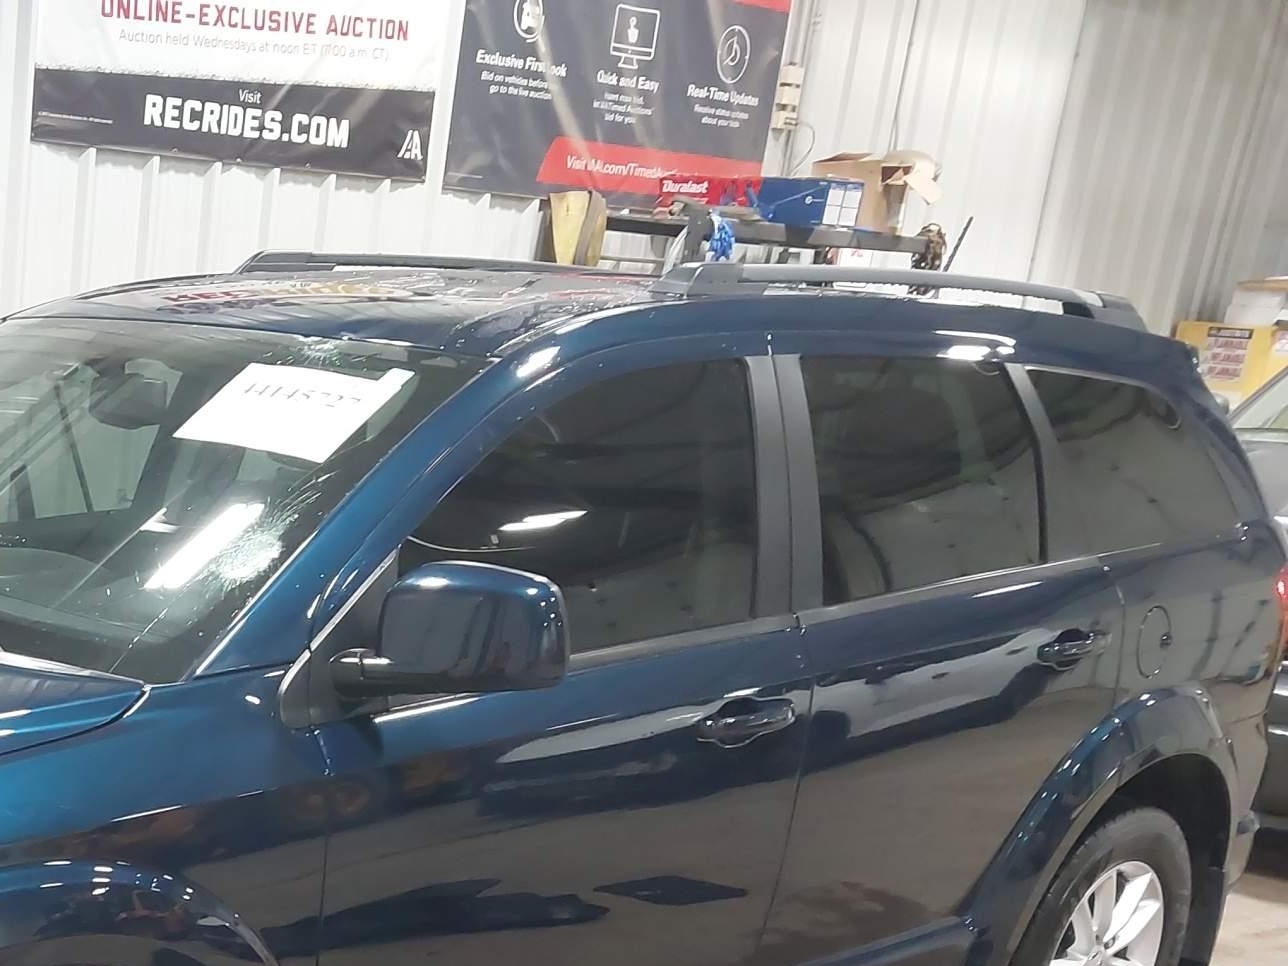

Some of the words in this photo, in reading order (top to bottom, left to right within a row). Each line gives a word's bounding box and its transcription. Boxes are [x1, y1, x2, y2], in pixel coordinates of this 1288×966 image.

[101, 0, 317, 35] ONLINE-EXCLUSIVE
[326, 14, 409, 41] AUCTION
[119, 28, 162, 44] Auction
[165, 31, 190, 46] held
[193, 34, 258, 53] Wednesdays
[475, 49, 524, 70] Exclusive
[619, 75, 637, 88] and
[638, 76, 660, 94] Easy
[687, 83, 730, 102] Real-Time
[238, 88, 262, 105] Visit
[143, 93, 350, 149] RECRIDES.COM
[566, 154, 587, 170] Visit
[663, 180, 709, 194] Duralast
